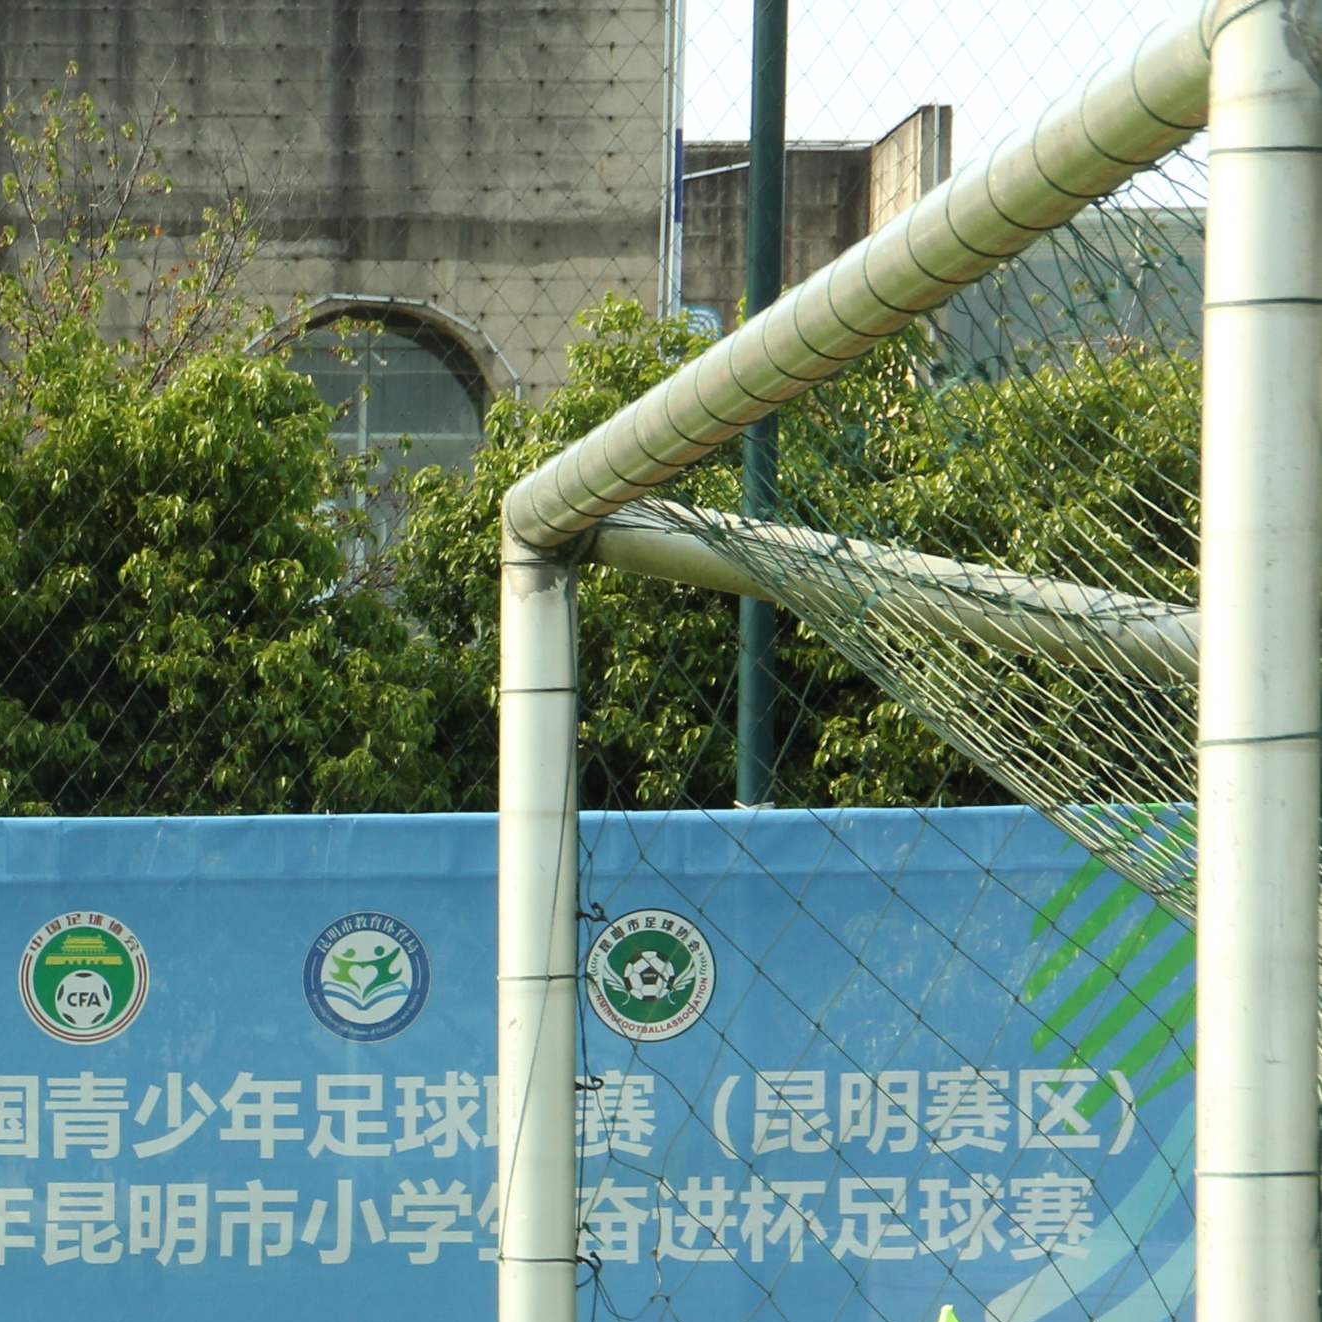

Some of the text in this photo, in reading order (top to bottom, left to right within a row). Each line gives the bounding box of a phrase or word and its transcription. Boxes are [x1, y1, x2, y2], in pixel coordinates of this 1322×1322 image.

[29, 913, 141, 952] 中国足球协会
[315, 915, 420, 954] 昆明市教育体育局
[599, 916, 701, 953] 昆明市足球协会
[67, 992, 102, 1007] CFA
